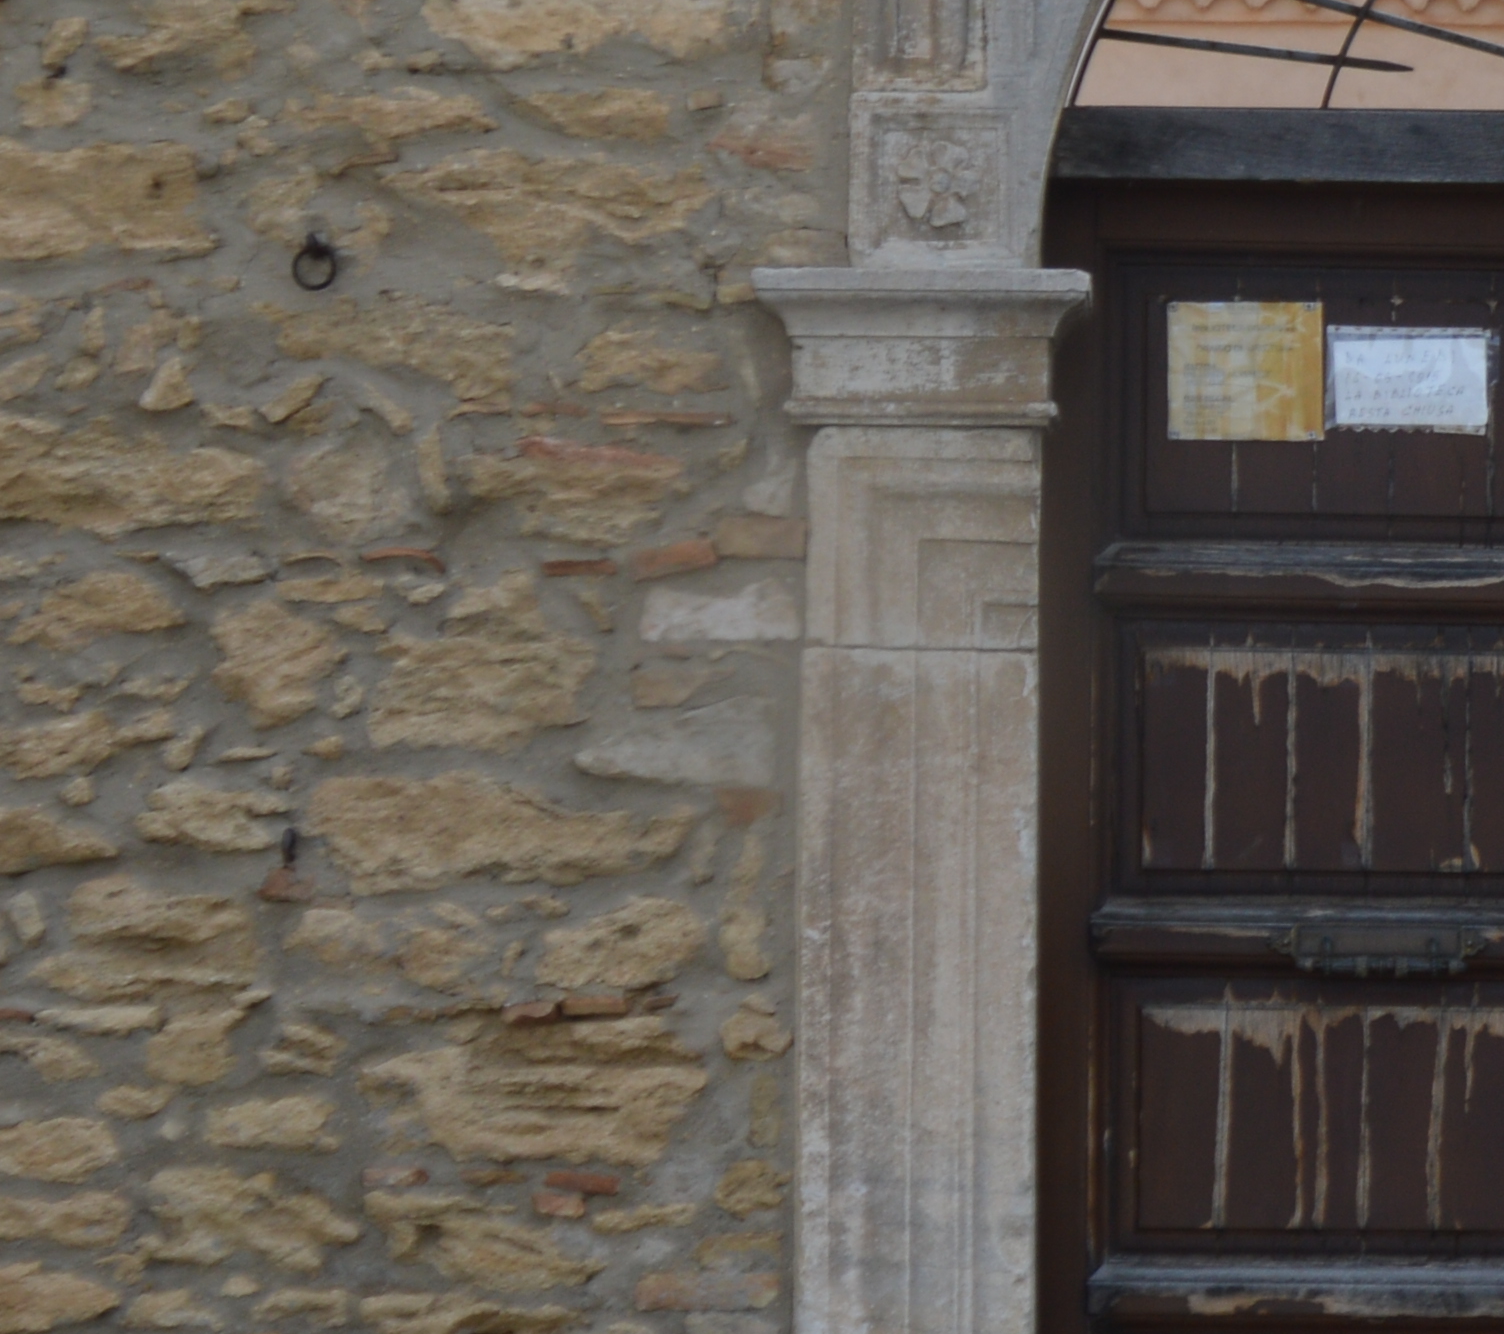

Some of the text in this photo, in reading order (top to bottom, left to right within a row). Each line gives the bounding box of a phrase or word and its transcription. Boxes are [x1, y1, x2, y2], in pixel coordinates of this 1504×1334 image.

[1345, 384, 1465, 401] LA BIBLIOTECA
[1349, 404, 1454, 420] RESTA CHIUSA
